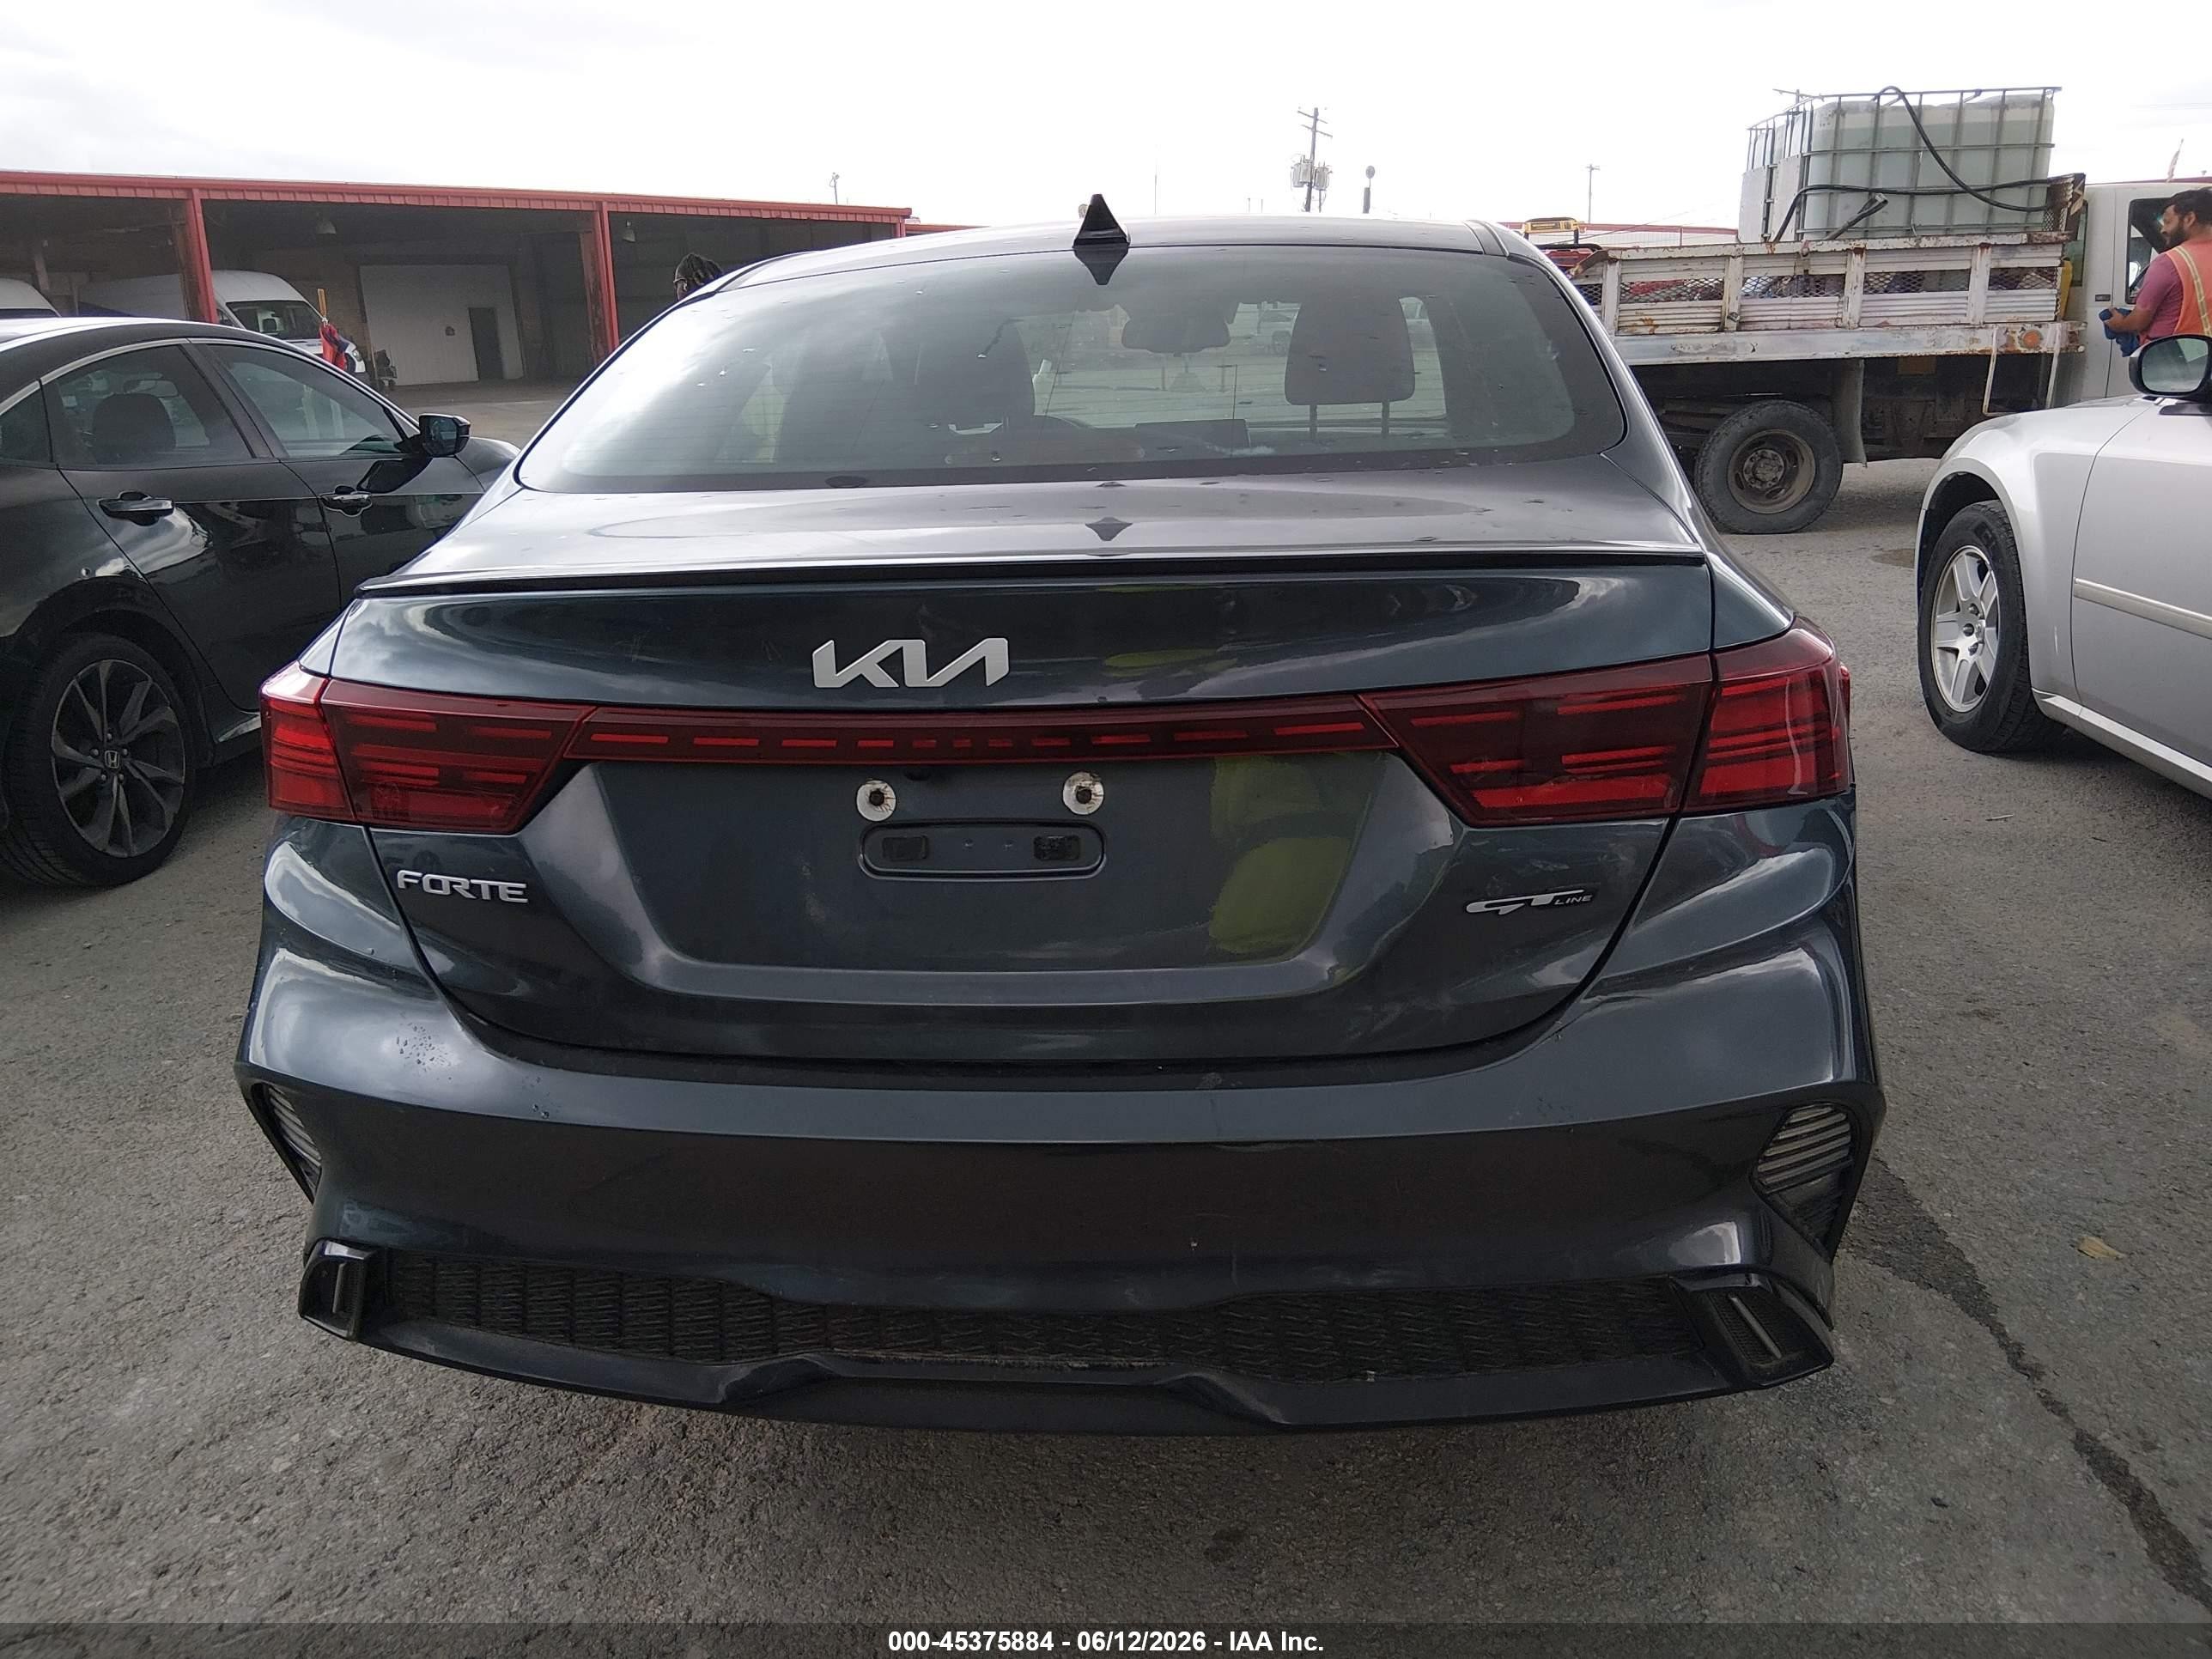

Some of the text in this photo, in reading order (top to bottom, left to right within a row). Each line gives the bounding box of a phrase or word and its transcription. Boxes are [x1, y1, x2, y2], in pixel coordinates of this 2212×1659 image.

[811, 637, 1010, 689] KIA
[397, 869, 529, 903] FORTE
[1466, 889, 1594, 916] GT LINE
